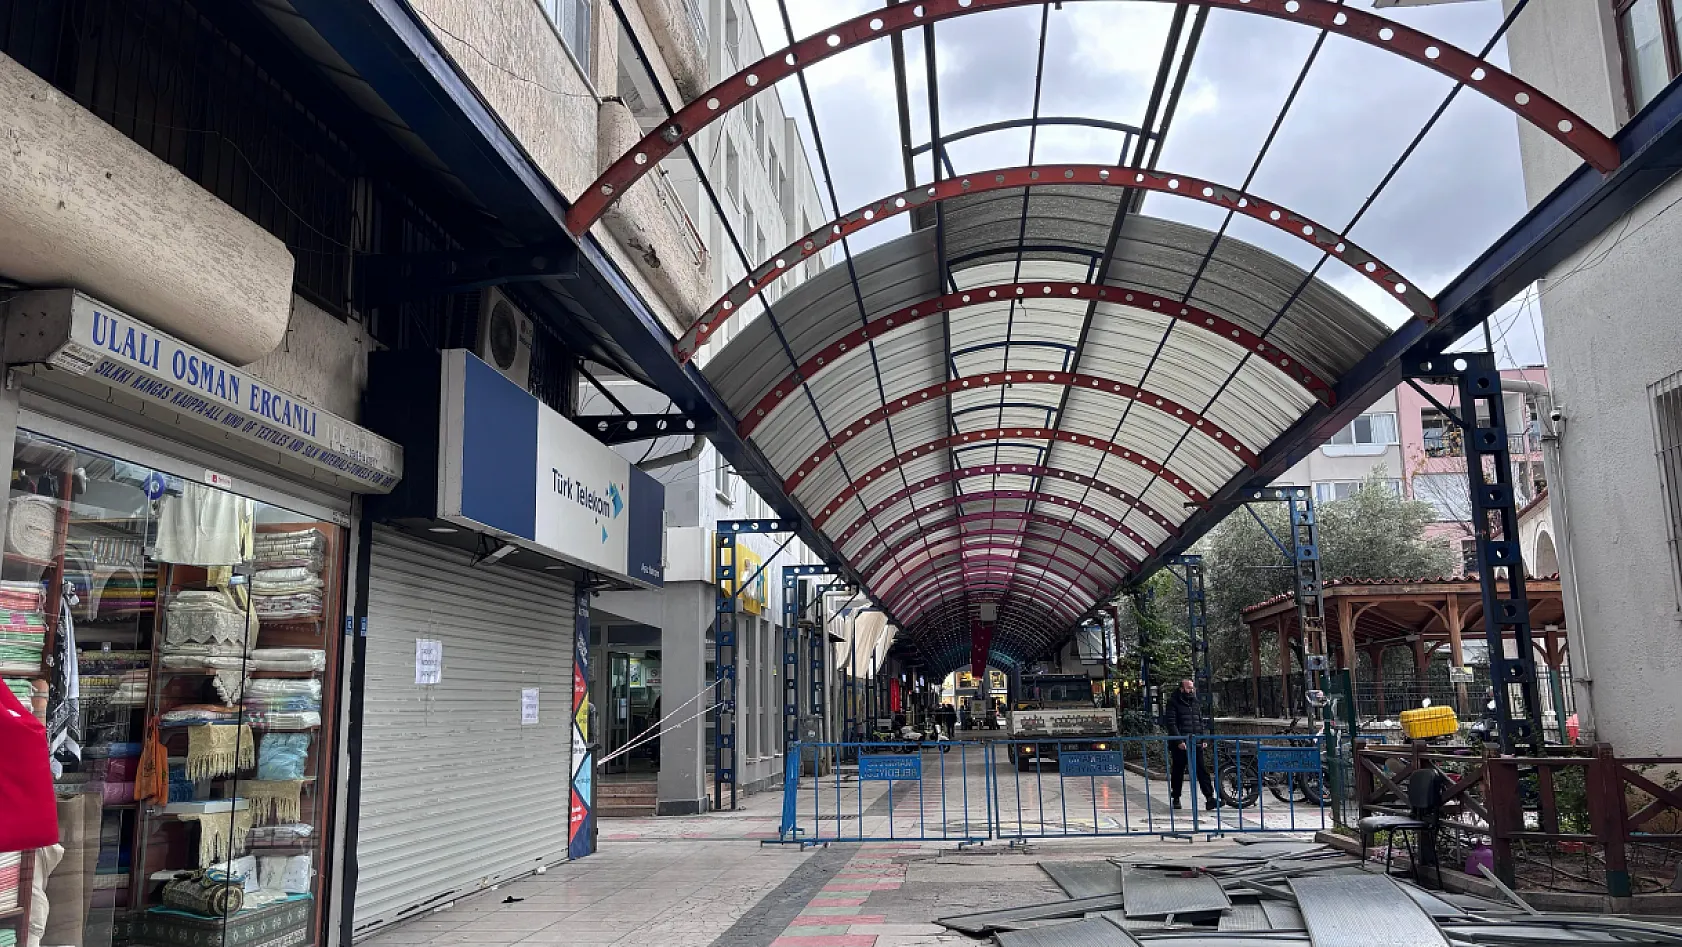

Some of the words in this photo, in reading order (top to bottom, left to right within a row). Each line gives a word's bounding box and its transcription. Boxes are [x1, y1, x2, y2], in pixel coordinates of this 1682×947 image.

[92, 311, 161, 370] ULALI
[172, 349, 240, 404] OSMAN
[249, 384, 316, 437] ERCANLI
[95, 360, 134, 385] SILKKI
[130, 375, 174, 400] KANGAS
[221, 412, 244, 429] KIND
[242, 420, 256, 433] OF
[254, 424, 290, 447] TEXTILES
[286, 438, 304, 452] AND
[301, 443, 321, 459] SILK
[552, 467, 573, 500] Türk
[575, 480, 610, 518] Telekom
